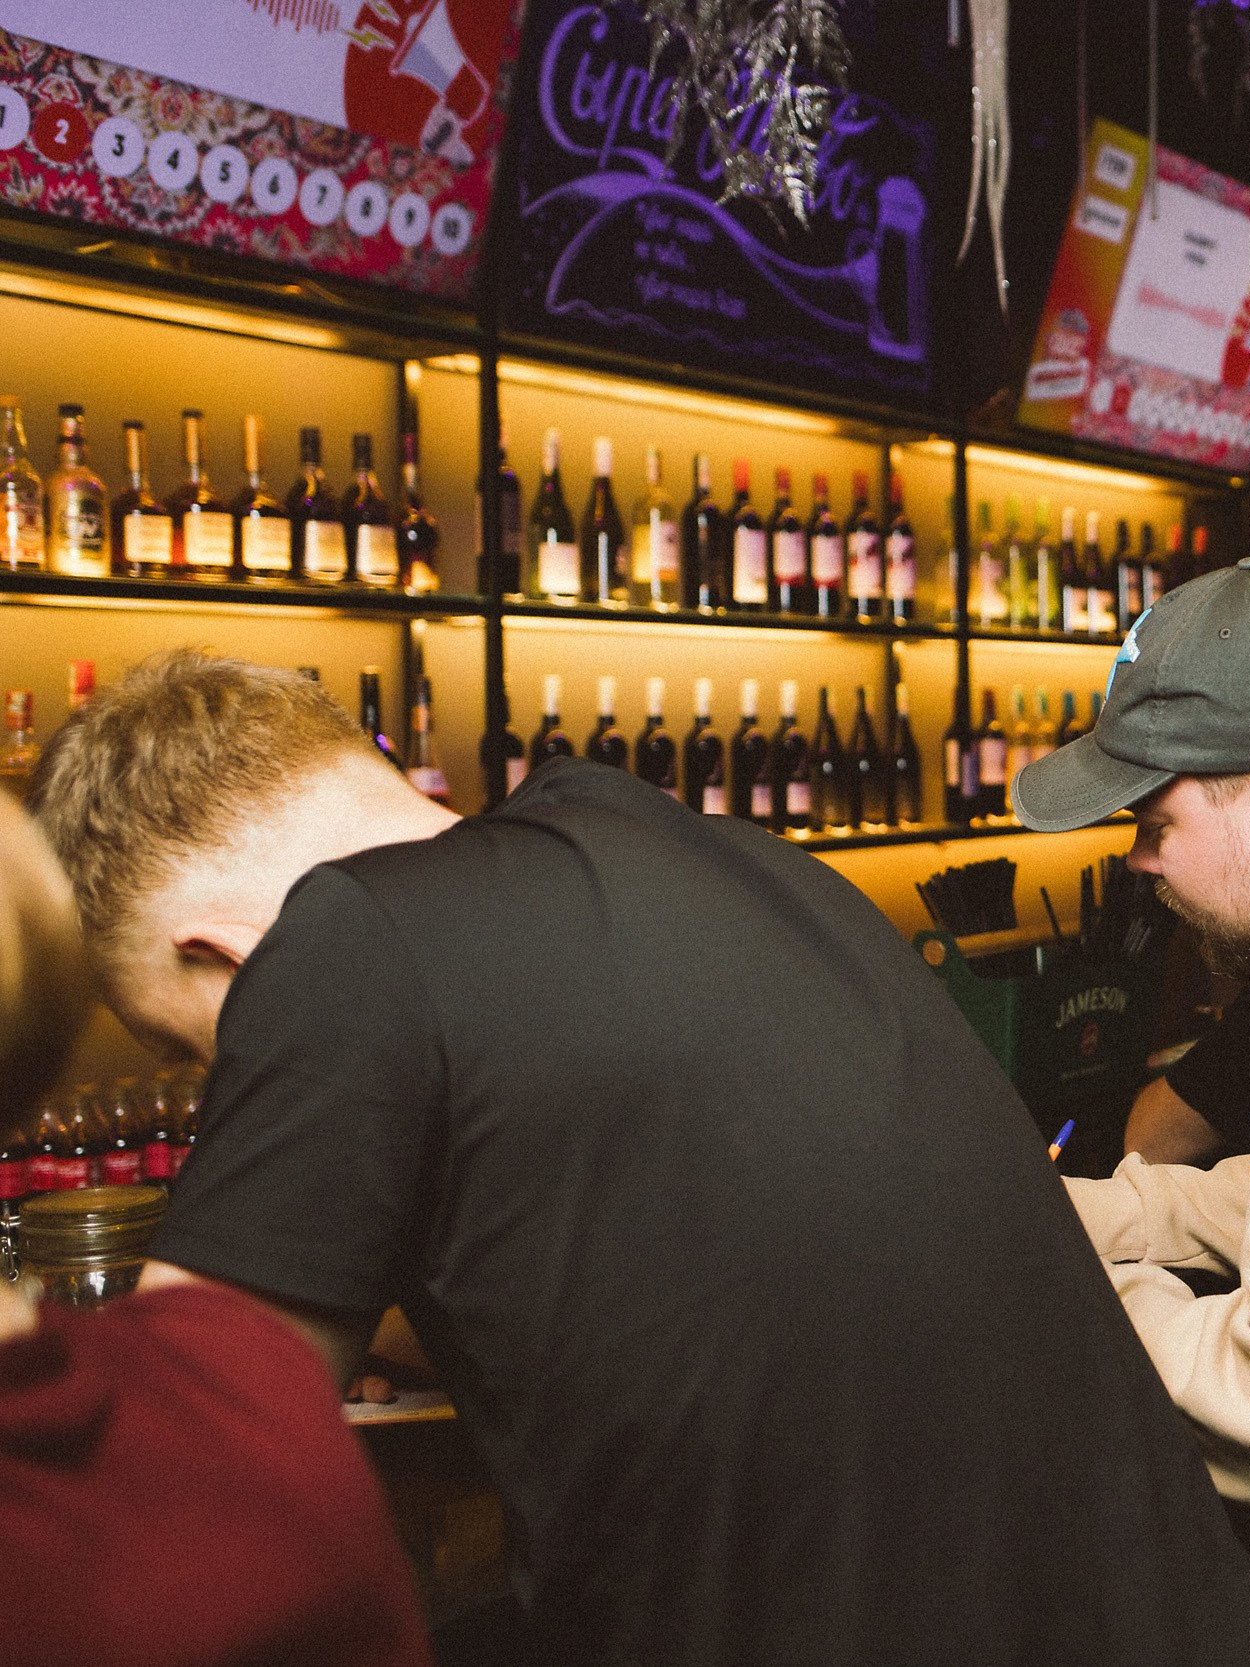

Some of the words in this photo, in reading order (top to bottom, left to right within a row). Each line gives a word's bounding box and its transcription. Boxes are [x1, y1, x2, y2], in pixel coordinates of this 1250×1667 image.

[54, 118, 70, 145] 2
[112, 133, 125, 157] 3
[166, 148, 180, 171] 4
[219, 160, 232, 182] 5
[268, 172, 280, 197] 6
[316, 184, 328, 206] 7
[1055, 985, 1130, 1029] JAMESON
